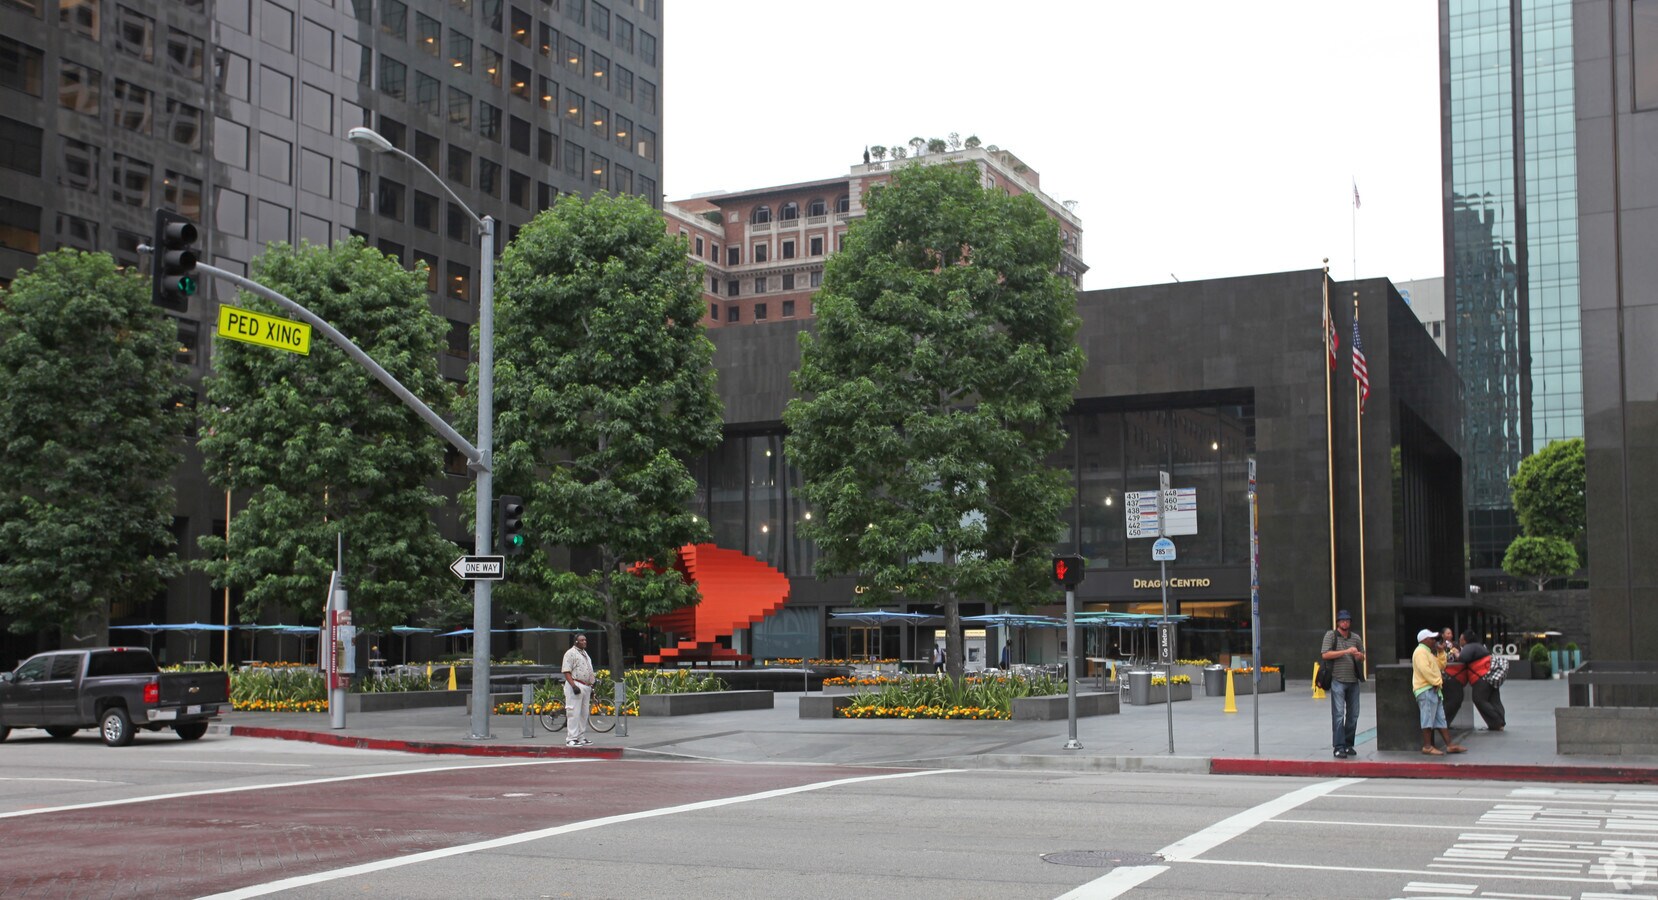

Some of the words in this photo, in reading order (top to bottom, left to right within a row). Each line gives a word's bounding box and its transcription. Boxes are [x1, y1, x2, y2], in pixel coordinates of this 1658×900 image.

[227, 312, 259, 336] PED
[265, 321, 302, 346] XING
[1164, 489, 1177, 497] 448
[465, 563, 480, 572] ONE
[482, 563, 498, 572] WAY
[1170, 577, 1211, 588] CENTRO
[1162, 647, 1168, 658] Go
